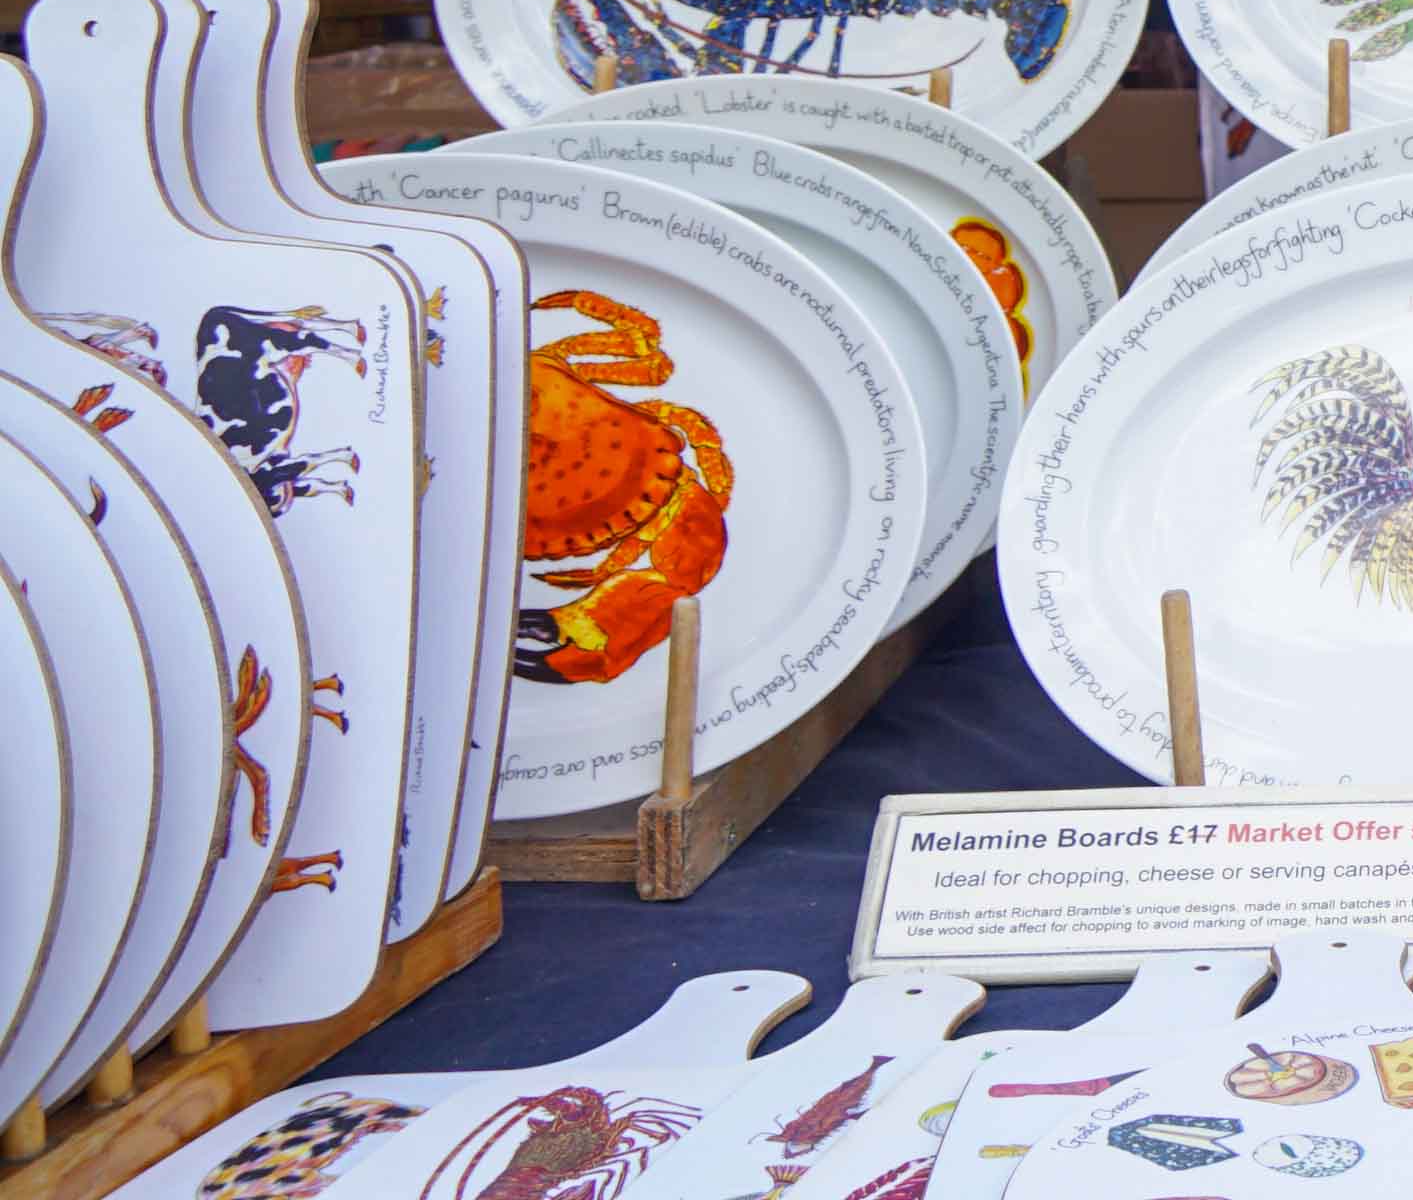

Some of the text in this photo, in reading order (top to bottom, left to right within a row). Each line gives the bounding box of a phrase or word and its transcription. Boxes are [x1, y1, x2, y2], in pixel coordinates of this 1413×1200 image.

[753, 151, 798, 178] Blue
[798, 173, 834, 199] crabs
[602, 190, 663, 231] Brown
[664, 211, 727, 255] (edible)
[728, 242, 774, 278] crabs
[773, 271, 799, 297] are
[799, 289, 865, 361] nocturnal
[852, 357, 896, 449] predators
[870, 448, 906, 503] living
[881, 516, 894, 544] on
[910, 829, 1048, 852] Melamine
[1056, 826, 1160, 848] Boards
[1168, 824, 1219, 845] £17
[1226, 821, 1325, 844] Market
[1332, 820, 1405, 842] Offer
[934, 871, 986, 889] Ideal
[993, 869, 1023, 887] for
[1027, 867, 1130, 889] chopping,
[1138, 865, 1215, 882] cheese
[1221, 867, 1243, 880] or
[1249, 861, 1326, 882] serving
[894, 908, 925, 921] With
[928, 907, 971, 920] British
[974, 906, 1008, 919] artist
[1010, 905, 1063, 918] Richard
[1066, 903, 1132, 917] Bramble's
[1135, 903, 1180, 917] unique
[1244, 900, 1281, 912] made
[1285, 900, 1297, 911] in
[1301, 898, 1336, 910] small
[1339, 897, 1392, 909] batches
[1395, 897, 1407, 909] in
[907, 925, 934, 937] Use
[938, 923, 974, 936] wood
[977, 922, 1005, 935] side
[1009, 921, 1047, 934] affect
[1050, 920, 1069, 932] for
[1071, 918, 1132, 935] chopping
[1136, 920, 1149, 931] to
[1153, 917, 1189, 930] avoid
[1193, 916, 1246, 930] marking
[1250, 916, 1264, 928] of
[1315, 914, 1348, 926] hand
[1352, 913, 1386, 924] wash
